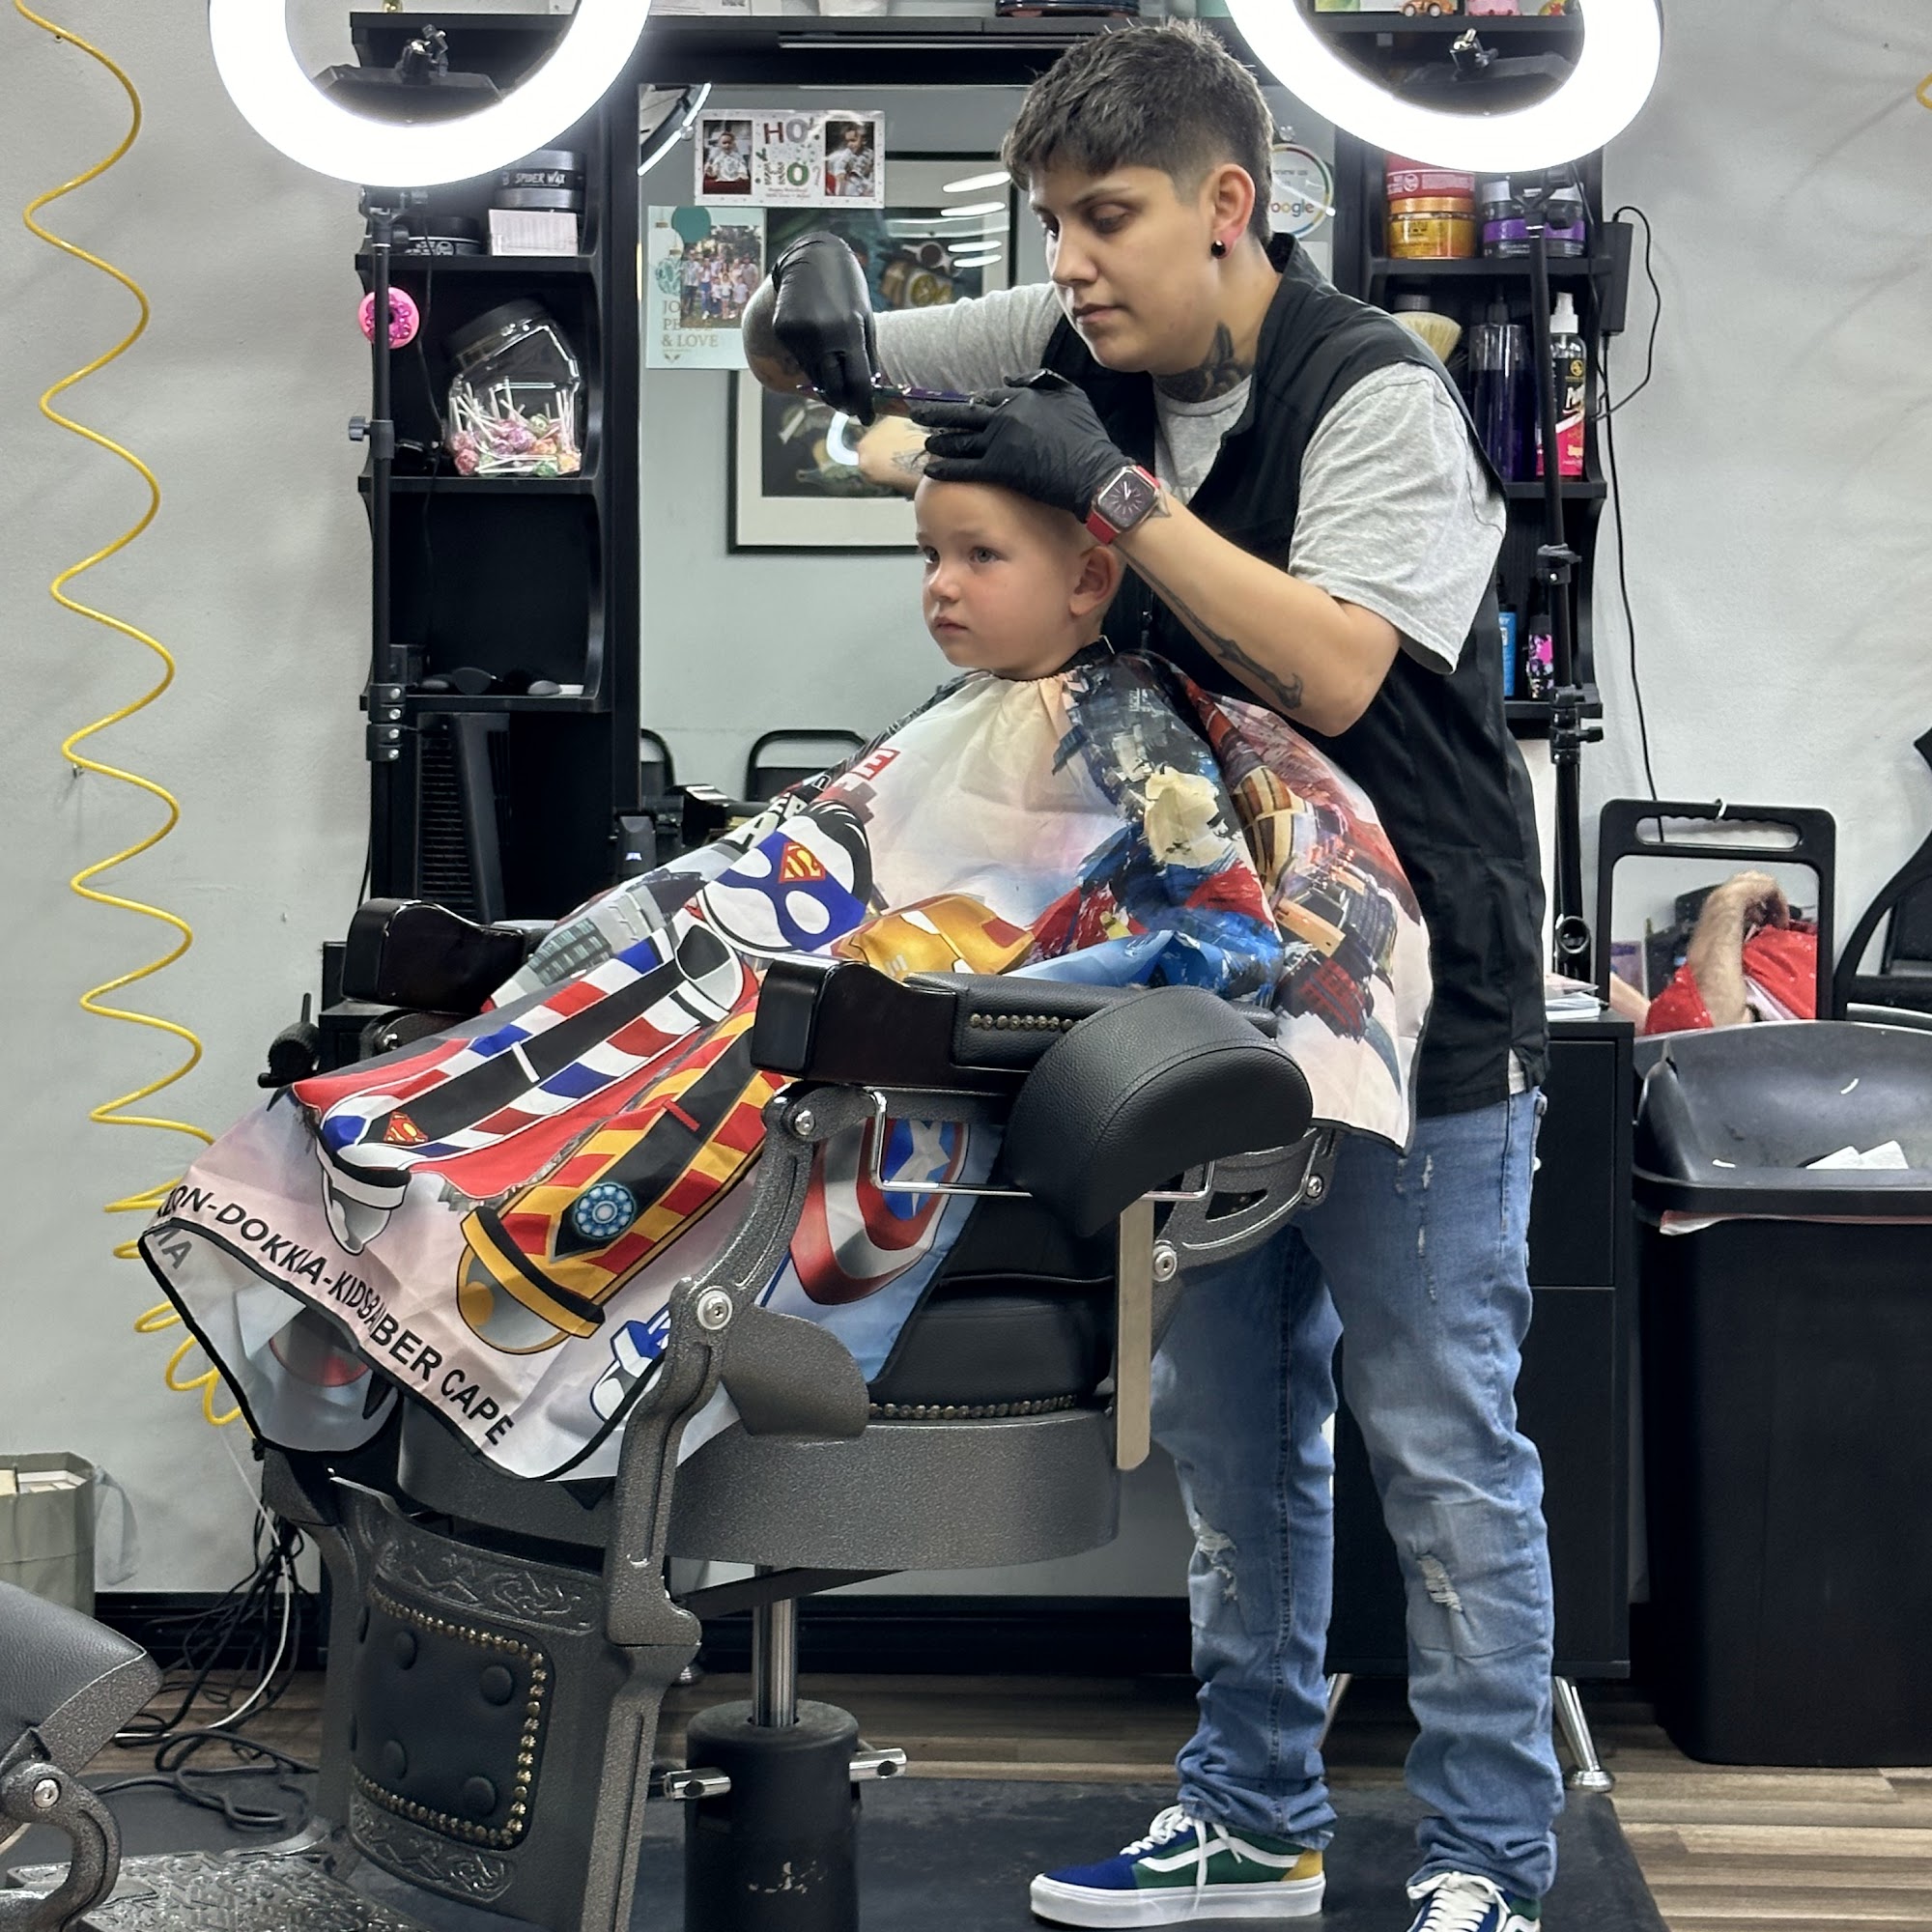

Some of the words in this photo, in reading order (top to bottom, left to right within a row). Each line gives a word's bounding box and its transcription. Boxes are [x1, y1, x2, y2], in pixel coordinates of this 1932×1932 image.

[763, 118, 808, 144] HO
[515, 172, 545, 184] SPIDER
[764, 161, 810, 186] HO
[1270, 198, 1315, 217] oogle
[662, 333, 672, 347] &
[677, 334, 719, 348] LOVE
[440, 1369, 515, 1446] CAPE
